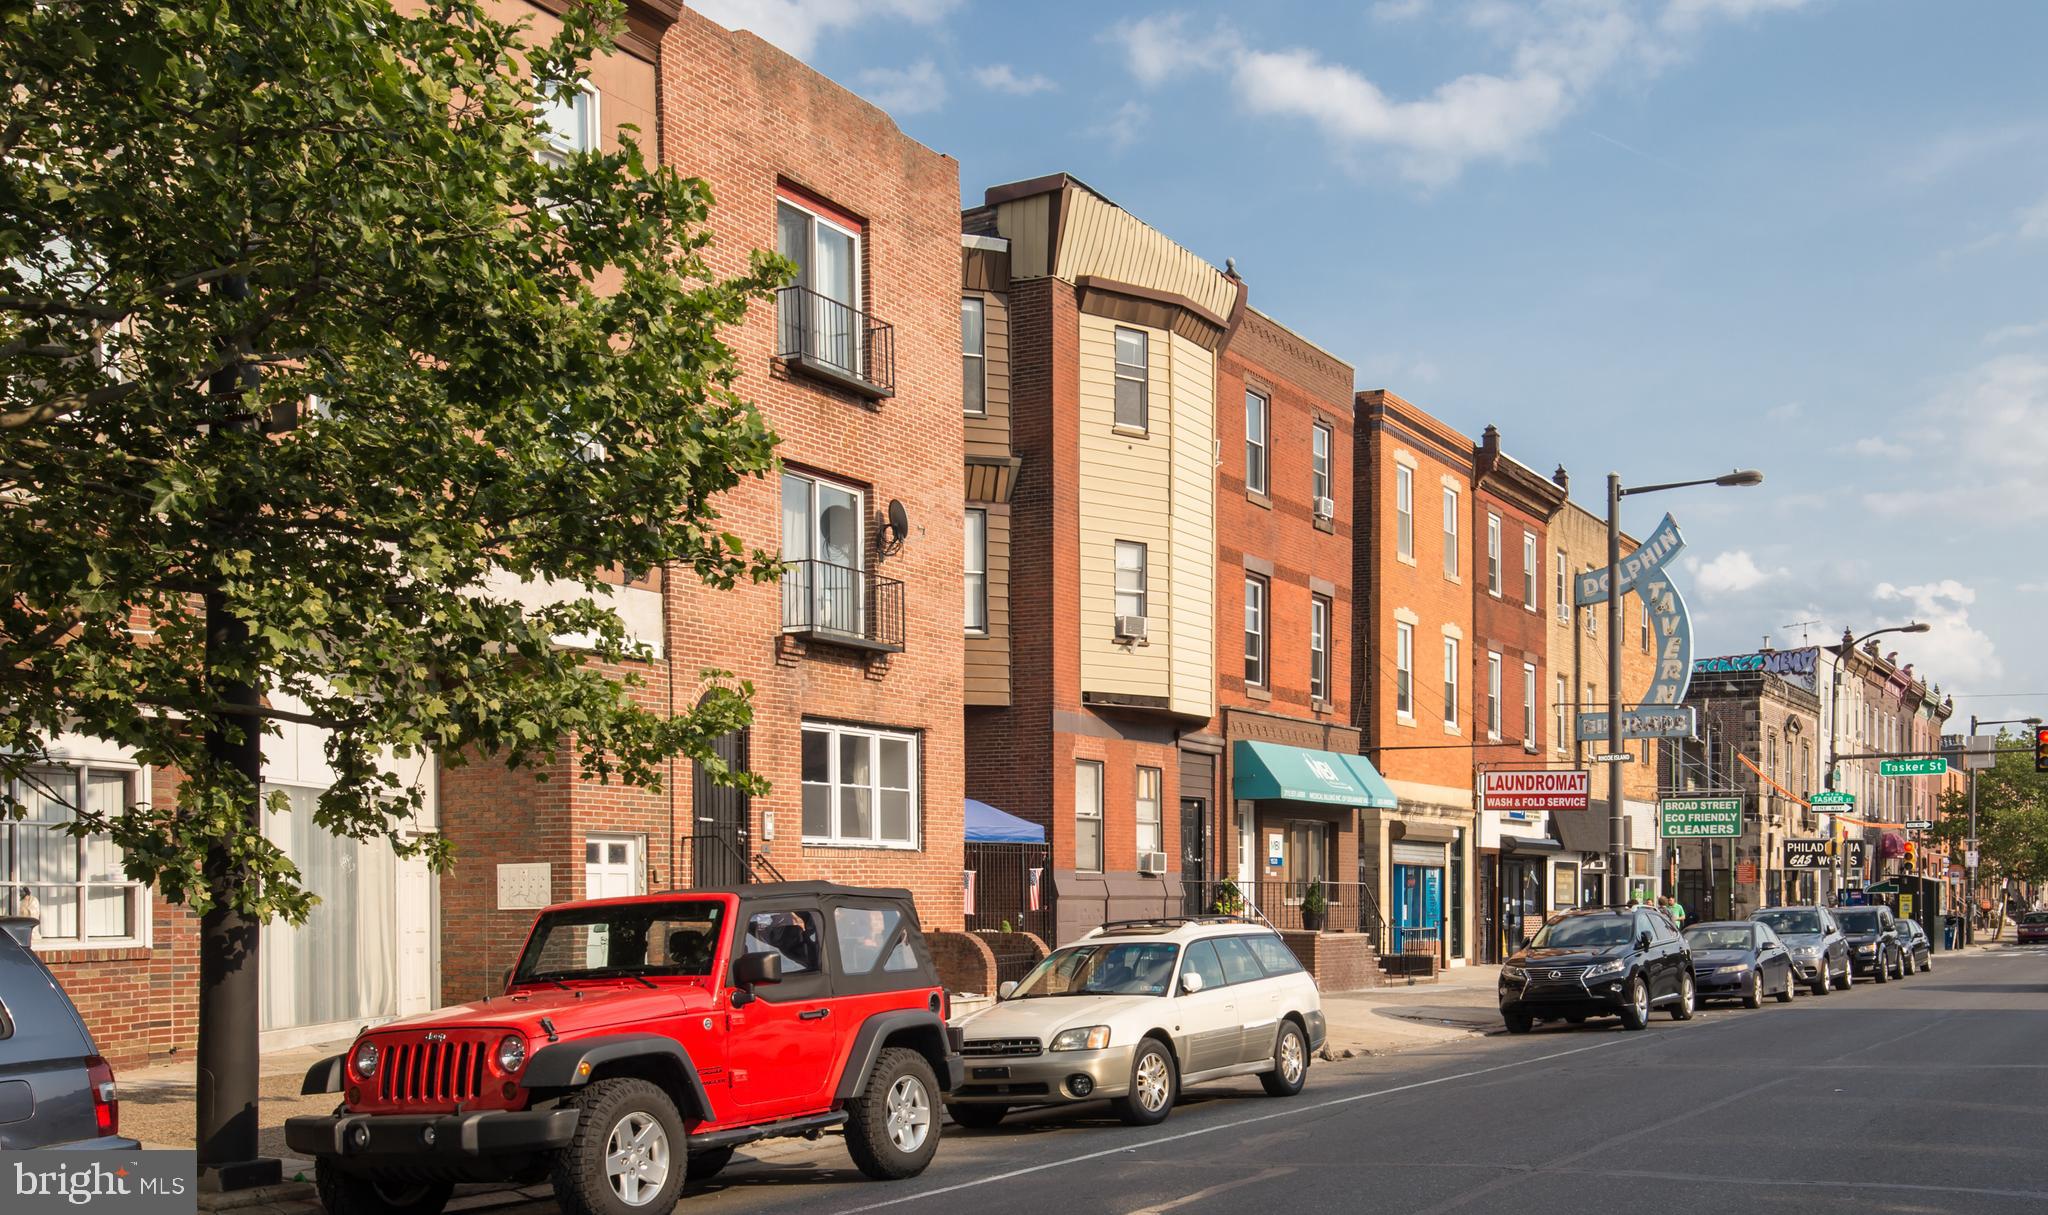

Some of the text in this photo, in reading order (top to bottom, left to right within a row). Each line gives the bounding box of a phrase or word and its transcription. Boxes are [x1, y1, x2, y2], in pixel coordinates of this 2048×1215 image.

[1647, 581, 1682, 704] TAVERN
[1885, 762, 1942, 772] Tasker St
[1487, 774, 1586, 791] LAUNDROMAT
[1487, 797, 1586, 807] WASH & FOLD SERVICE
[1665, 801, 1738, 810] BROAD STREET
[1665, 813, 1737, 822] ECO FRIENDLY
[1668, 825, 1734, 834] CLEANERS
[1787, 842, 1860, 853] PHILADIA
[1789, 854, 1857, 865] GAS WRS
